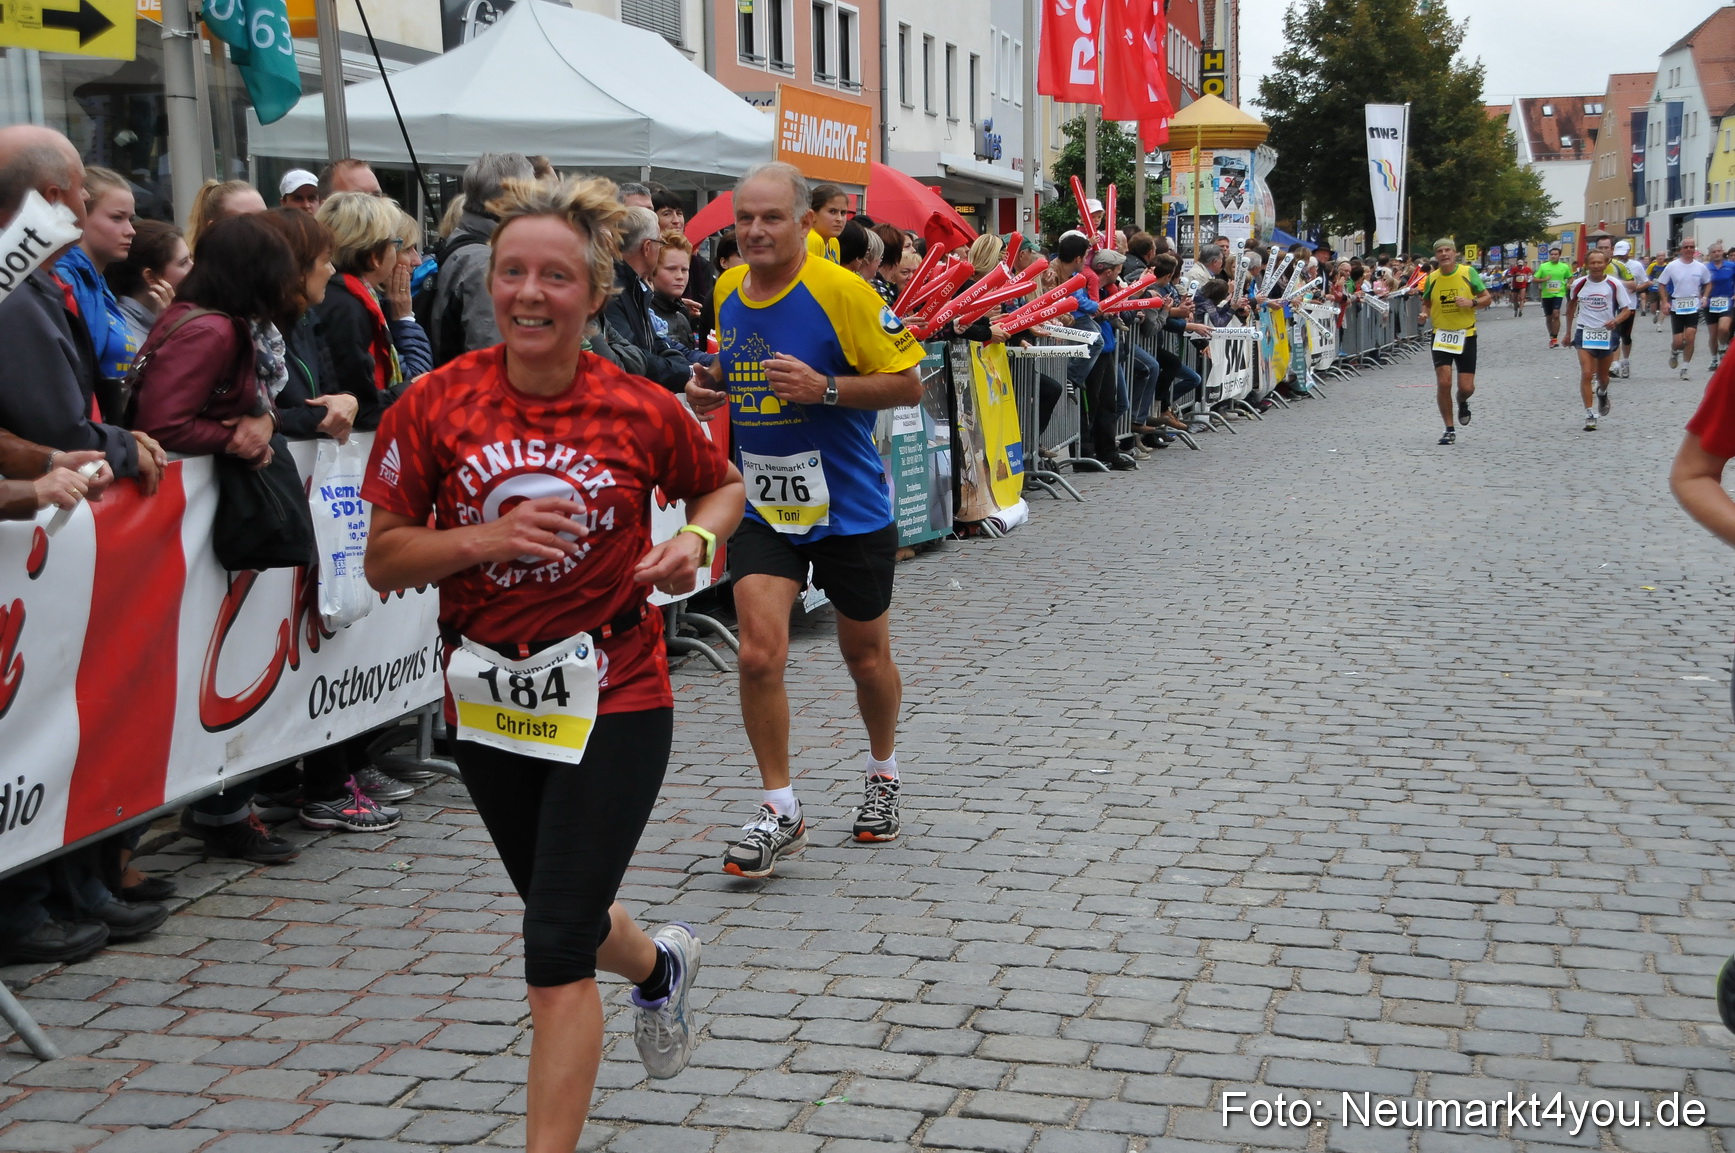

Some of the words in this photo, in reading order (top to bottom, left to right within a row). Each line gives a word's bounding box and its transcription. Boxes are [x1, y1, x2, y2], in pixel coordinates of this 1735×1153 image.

[971, 283, 989, 298] Audi
[956, 295, 972, 309] BKK
[1031, 298, 1047, 310] BKK
[1002, 320, 1019, 333] Audi
[1019, 314, 1035, 326] BKK
[1441, 332, 1459, 344] 300
[1585, 331, 1608, 341] 3353
[457, 439, 617, 497] FINISHER
[765, 462, 806, 472] Neumarkt
[755, 475, 811, 502] 276
[457, 502, 482, 525] 20
[589, 506, 615, 531] 14
[776, 509, 800, 521] Toni
[308, 646, 428, 720] Ostbayerns
[478, 666, 570, 710] 184
[496, 712, 558, 739] Christa
